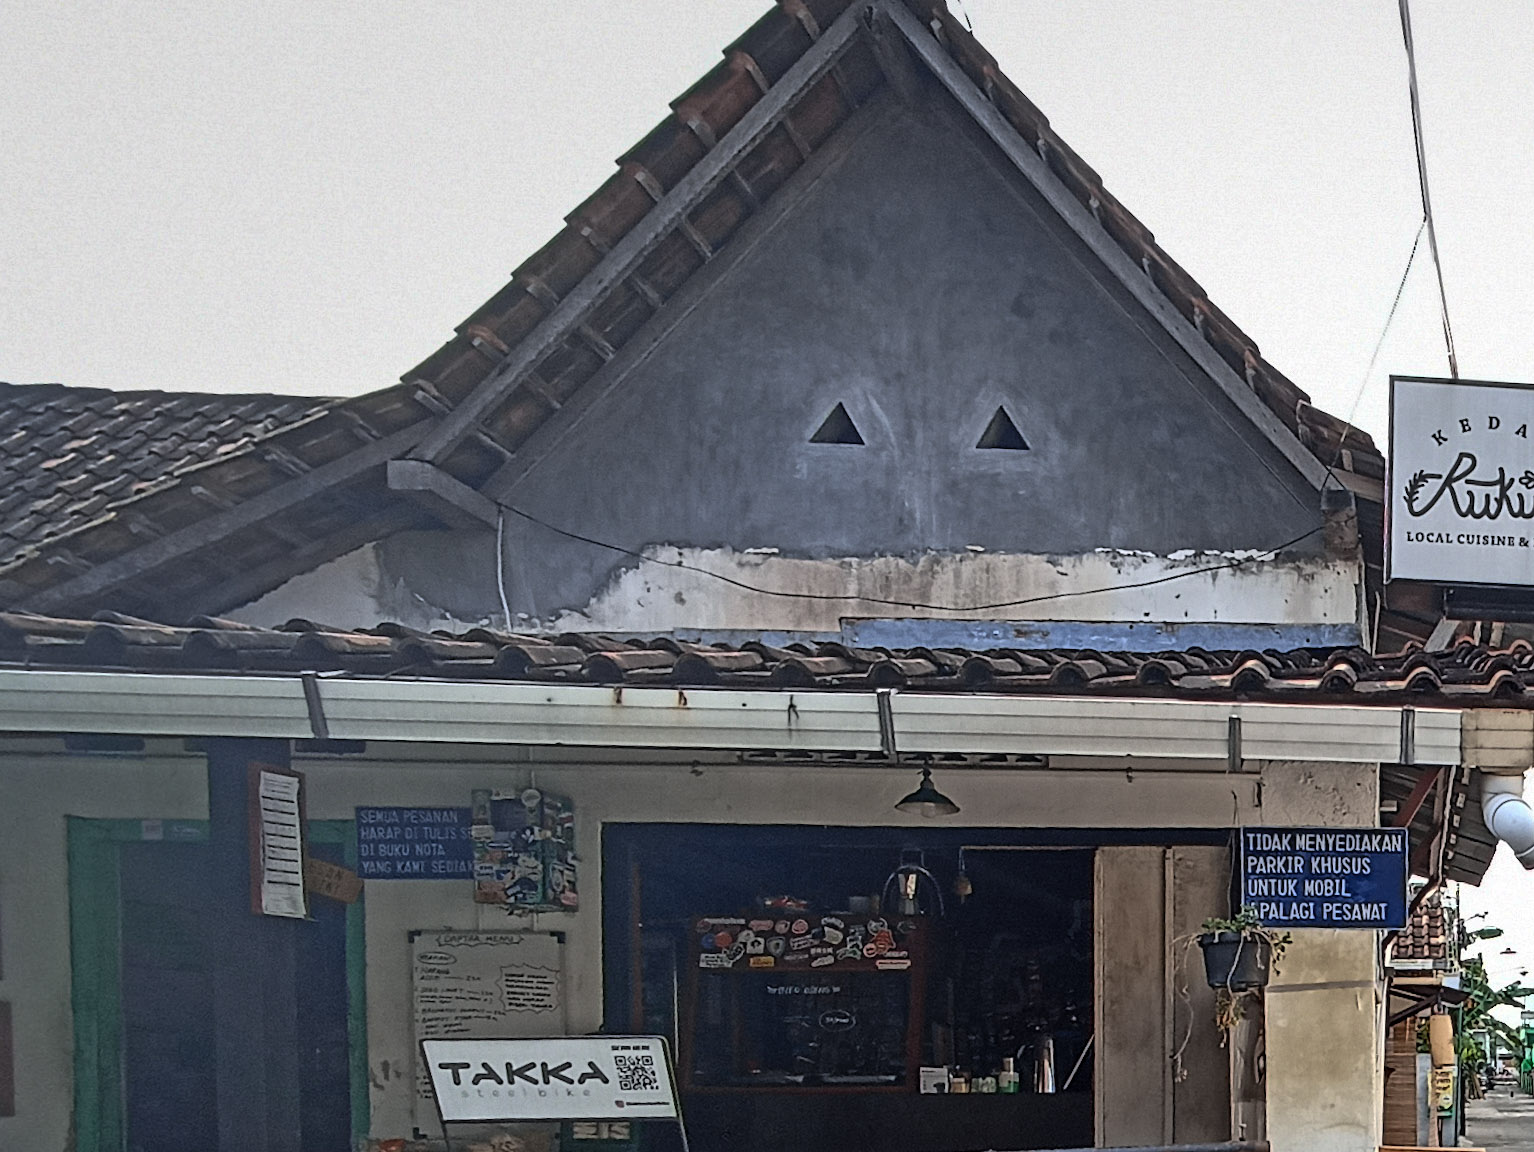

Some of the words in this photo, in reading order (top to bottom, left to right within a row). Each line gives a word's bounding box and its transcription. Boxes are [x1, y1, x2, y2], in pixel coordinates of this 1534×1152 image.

[1406, 531, 1453, 544] LOCAL
[1457, 533, 1515, 547] CUISINE
[1518, 536, 1529, 547] &
[360, 809, 400, 823] SEMUA
[403, 809, 458, 824] PESANAN
[360, 826, 400, 840] HARAP
[404, 827, 418, 840] DI
[423, 826, 457, 840] TULIS
[360, 843, 375, 857] DI
[378, 843, 409, 857] BUKU
[415, 843, 445, 856] NOTA
[1246, 833, 1292, 851] TIDAK
[1296, 833, 1402, 853] MENYEDIAKAN
[361, 860, 392, 873] YANG
[396, 860, 425, 873] KAMI
[1247, 856, 1305, 874] PARKIR
[1311, 856, 1371, 875] KHUSUS
[1247, 879, 1298, 897] UNTUK
[1304, 879, 1352, 897] MOBIL
[1323, 902, 1388, 921] PESAWAT
[438, 1061, 609, 1086] TAKKA
